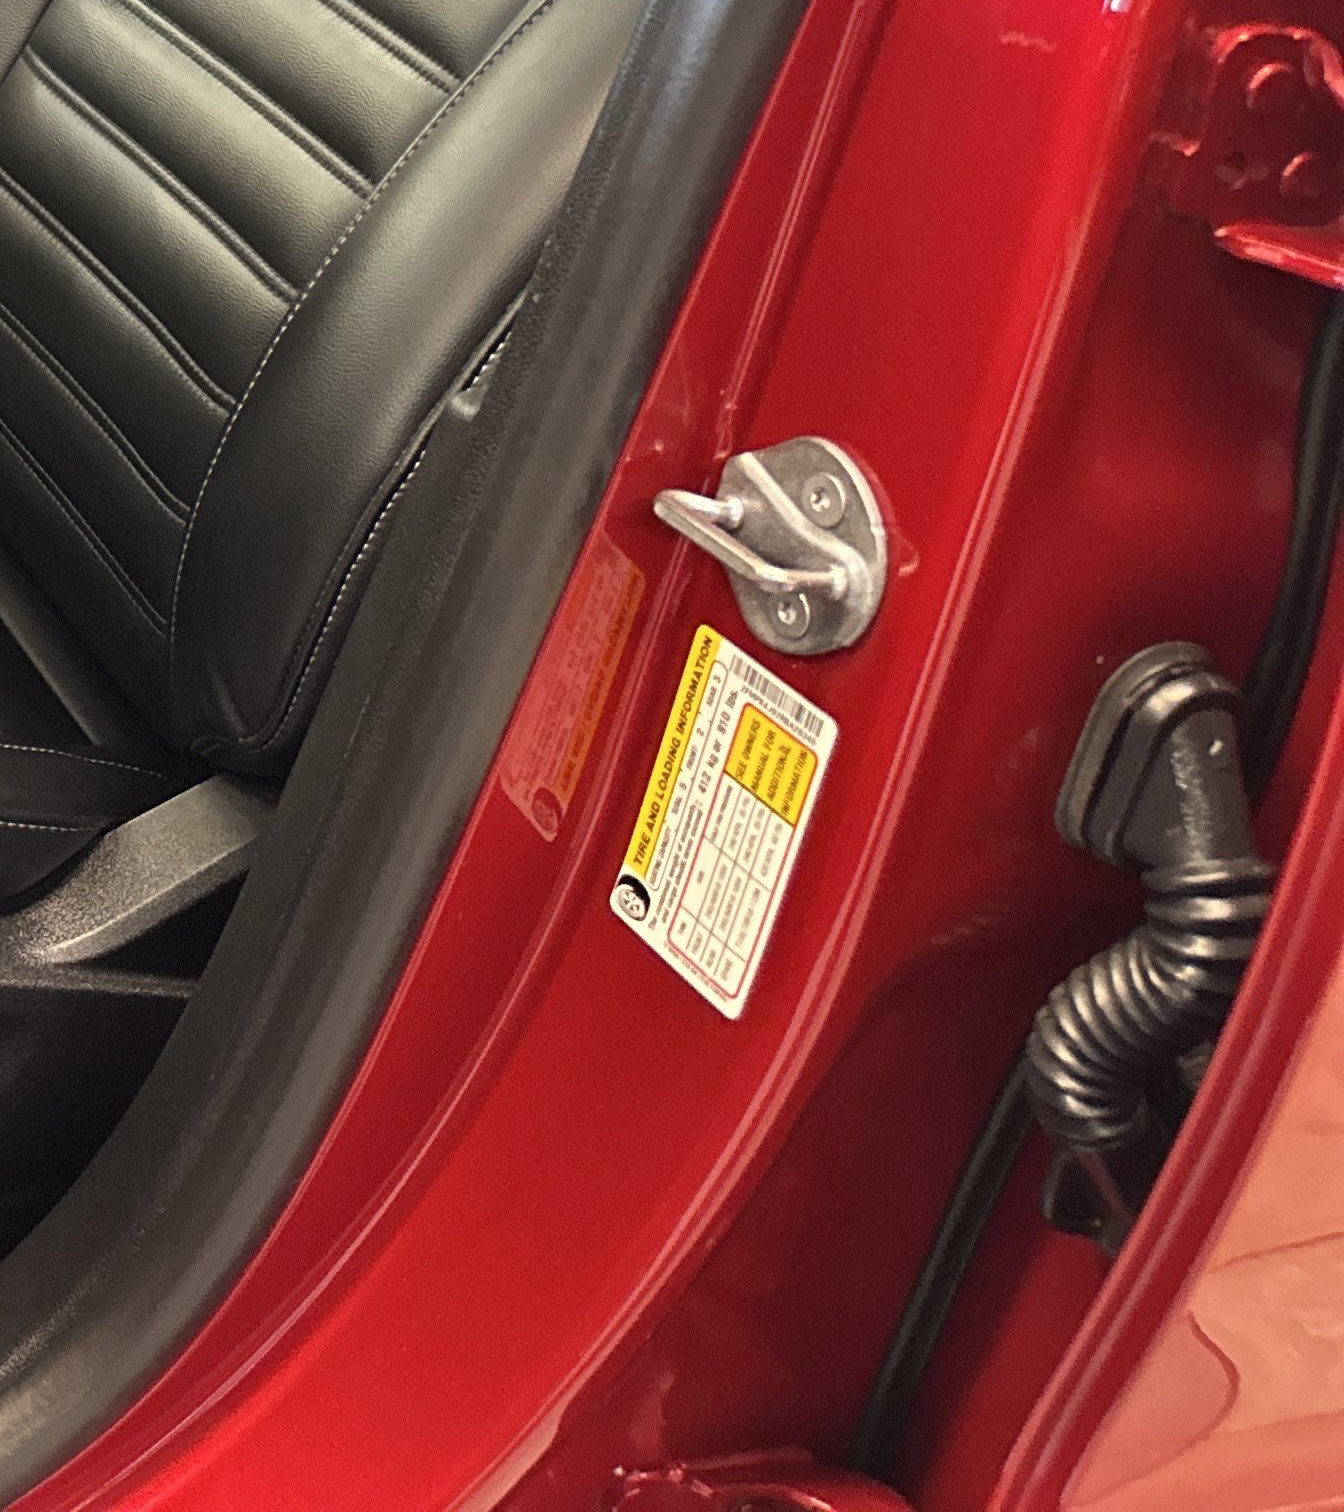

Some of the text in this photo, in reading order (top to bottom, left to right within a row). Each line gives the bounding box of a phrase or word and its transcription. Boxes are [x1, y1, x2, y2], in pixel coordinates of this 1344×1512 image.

[633, 635, 713, 866] TIRE AND LOADING INFORMATION
[697, 770, 711, 793] 412
[705, 753, 719, 769] kg
[735, 760, 747, 780] SEE
[741, 718, 760, 760] OWNERS
[750, 752, 769, 791] MANUAL
[762, 729, 776, 751] FOR
[780, 749, 807, 816] INFORMATION
